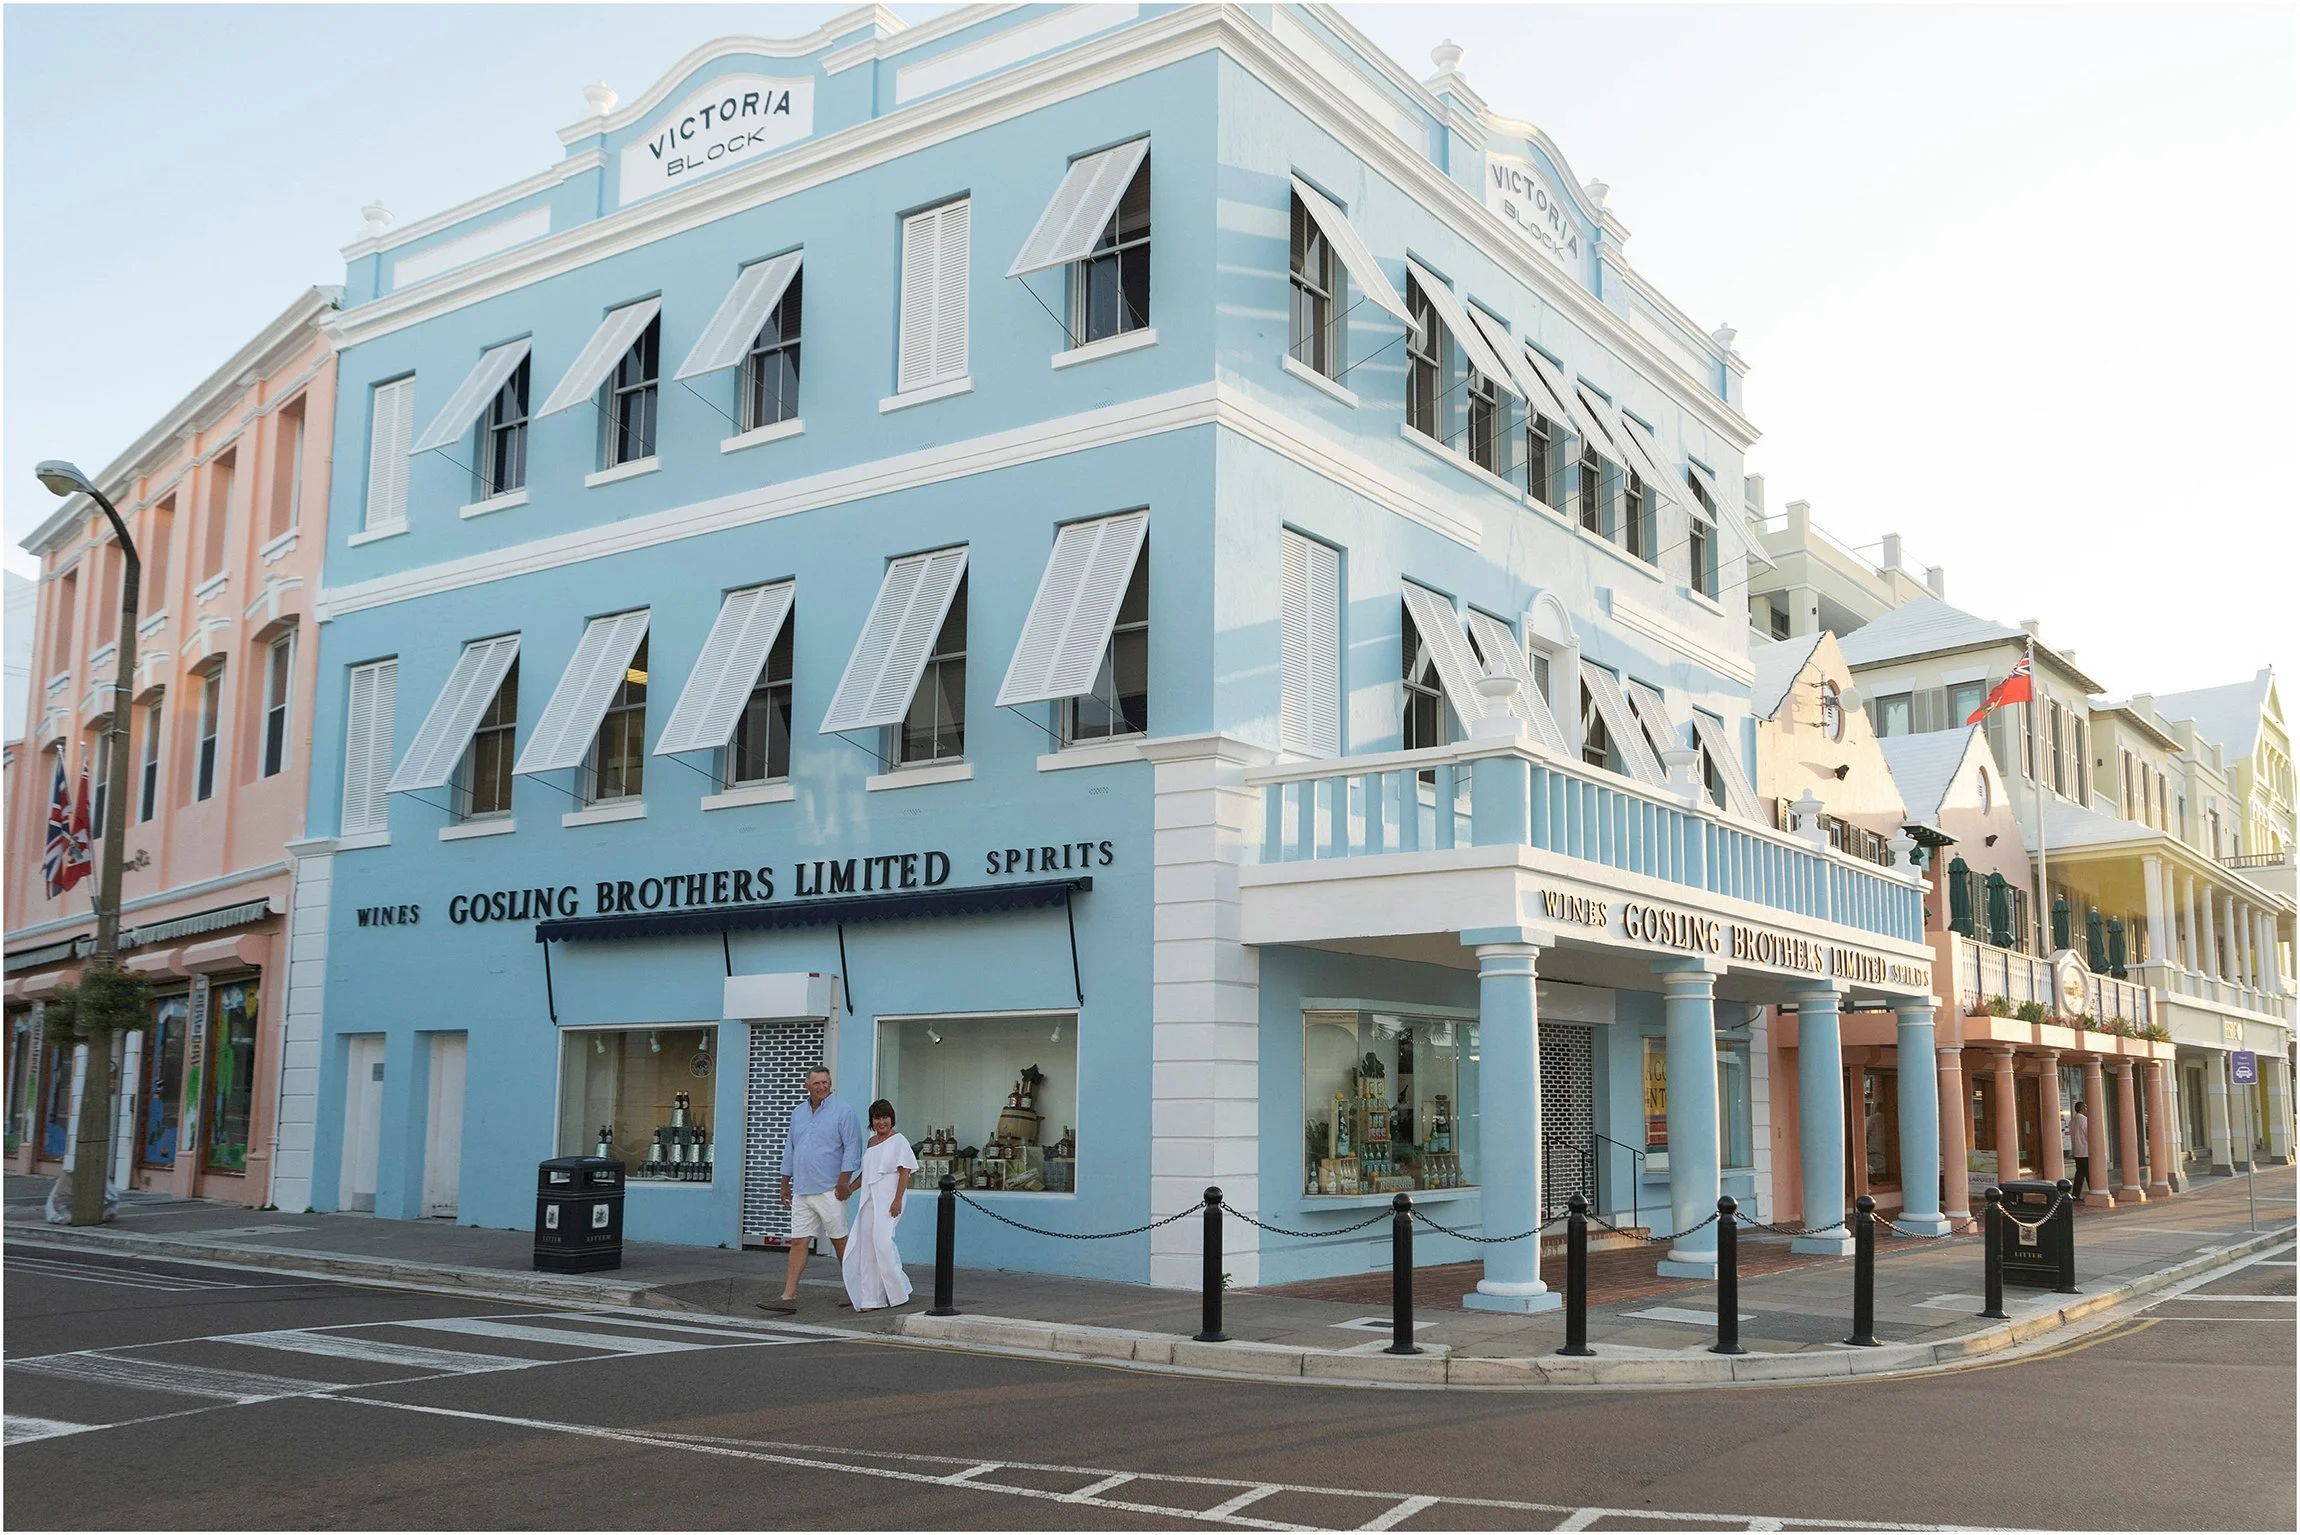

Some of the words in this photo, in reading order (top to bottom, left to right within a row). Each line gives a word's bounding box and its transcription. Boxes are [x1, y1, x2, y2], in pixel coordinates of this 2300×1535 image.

[648, 90, 791, 160] VICTORIA
[667, 126, 767, 177] BLOCK
[1491, 163, 1578, 260] VICTORIA
[1504, 198, 1565, 262] BLOCK
[356, 904, 421, 928] WINES
[449, 885, 580, 925] GOSLING
[596, 866, 774, 914] BROTHERS
[794, 850, 951, 896] LIMITED
[985, 840, 1114, 876] SPIRITS
[1541, 889, 1608, 928] WINES
[1623, 902, 1721, 955] GOSLING
[1731, 924, 1824, 973] BROTHERS
[1830, 946, 1887, 984] LIMITED
[1892, 964, 1929, 987] SPIRITS
[2014, 1251, 2043, 1259] LITTER
